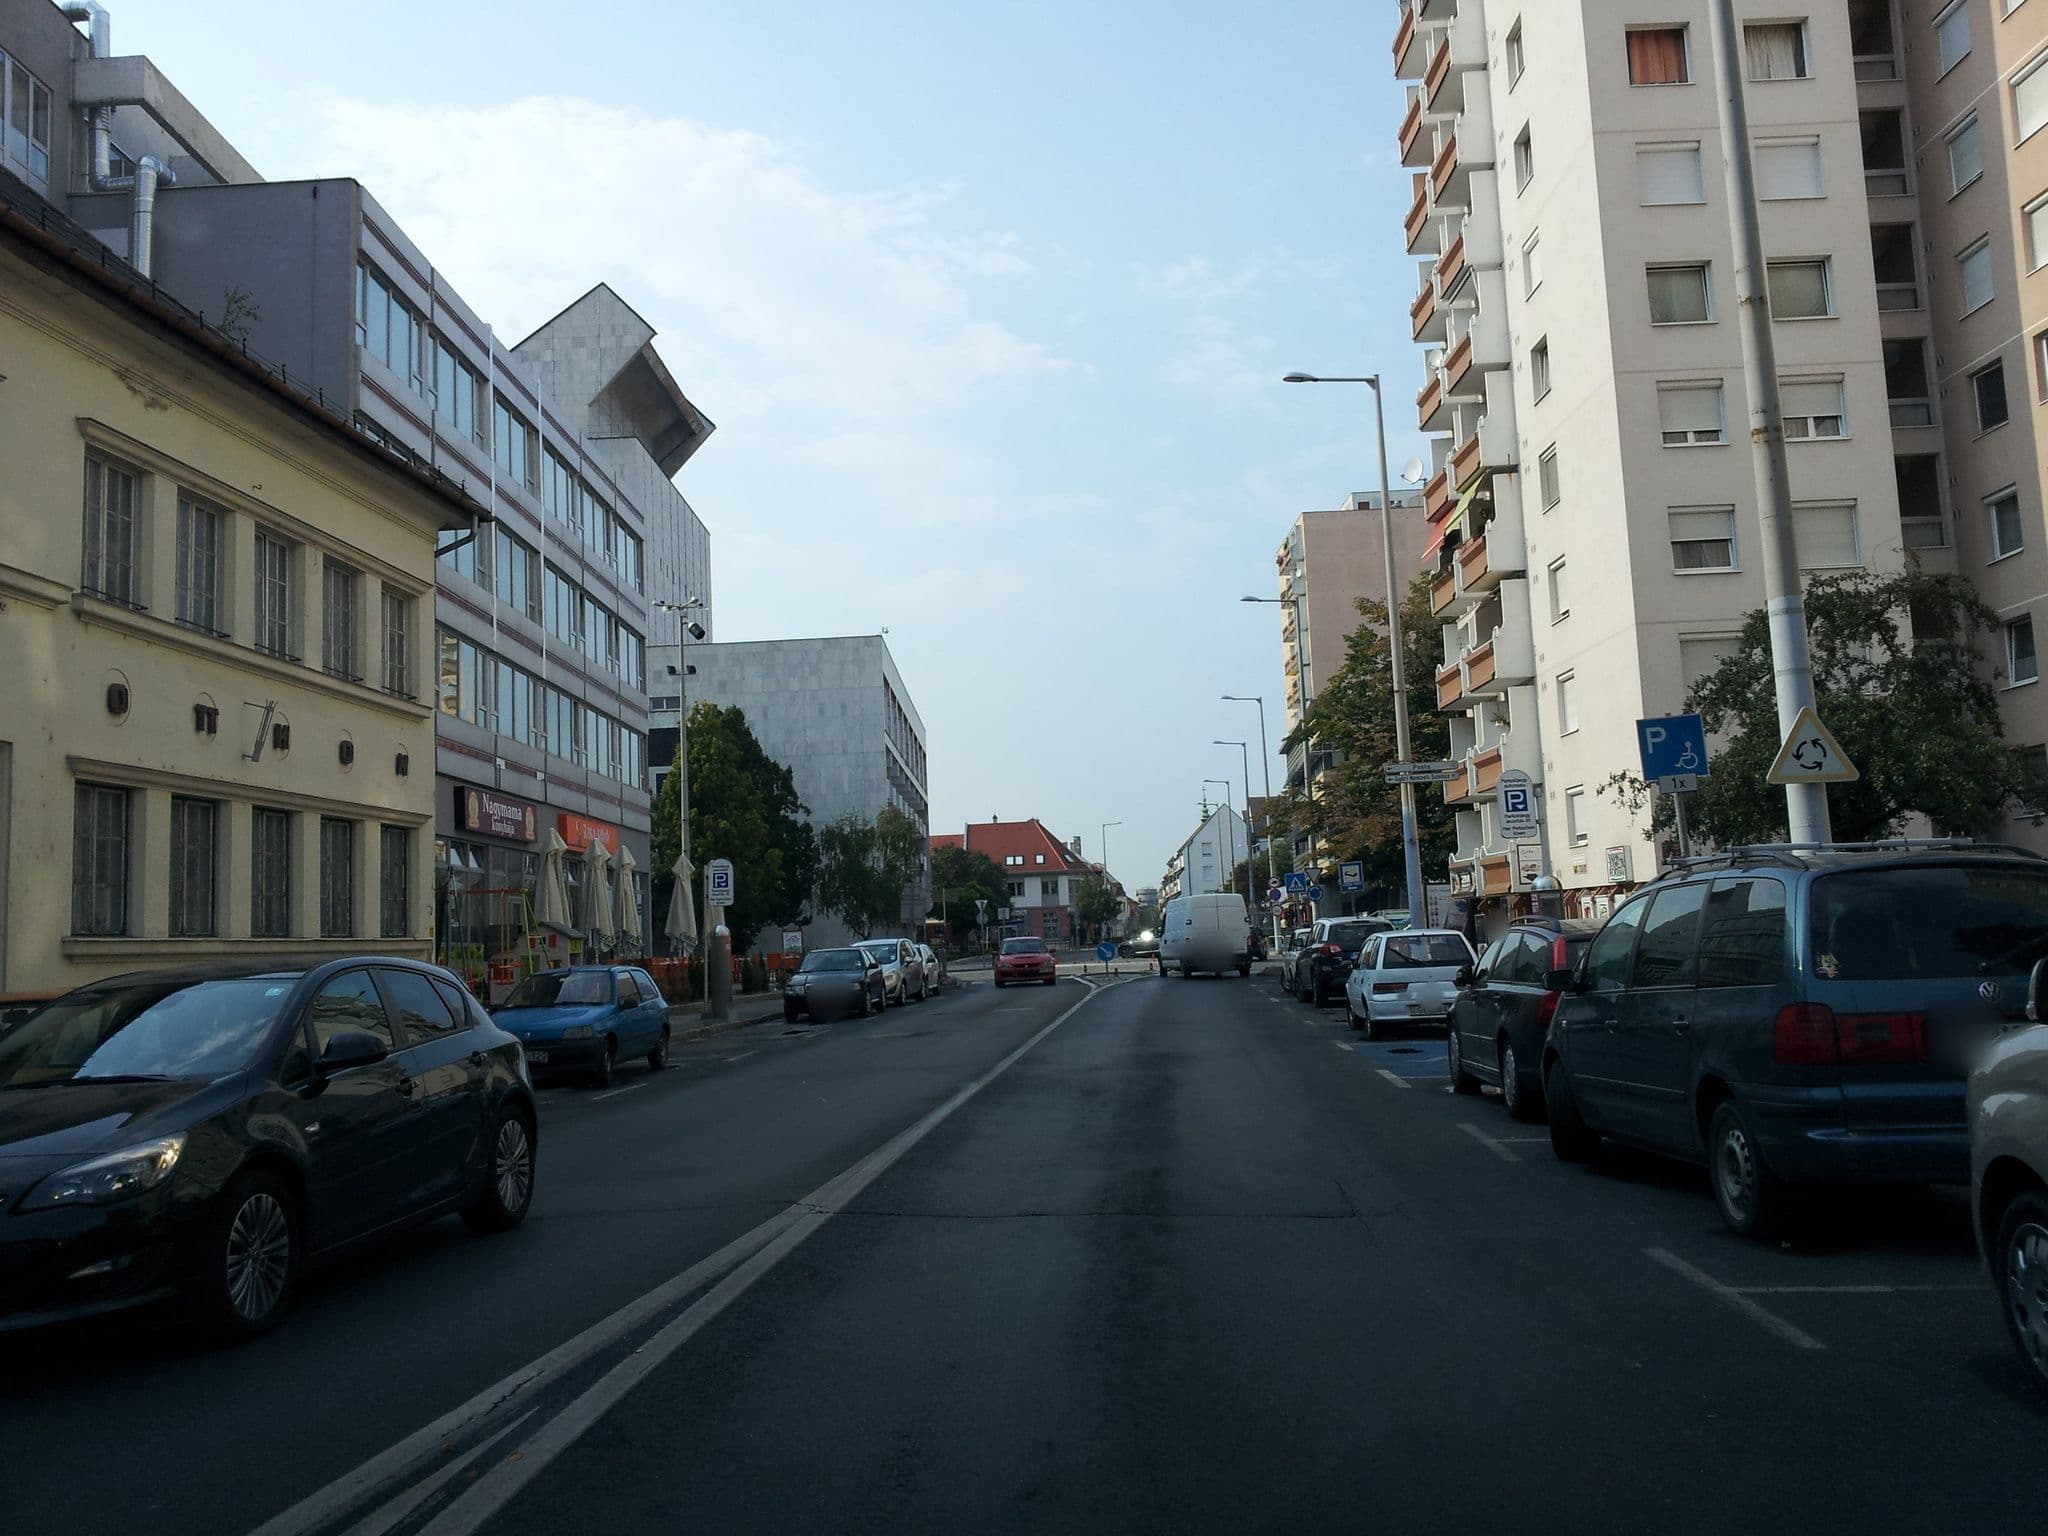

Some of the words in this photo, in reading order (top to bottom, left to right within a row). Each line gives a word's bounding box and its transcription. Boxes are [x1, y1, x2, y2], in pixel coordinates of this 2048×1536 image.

[1646, 727, 1666, 754] P
[482, 792, 522, 821] Nagymama
[1507, 791, 1524, 811] P
